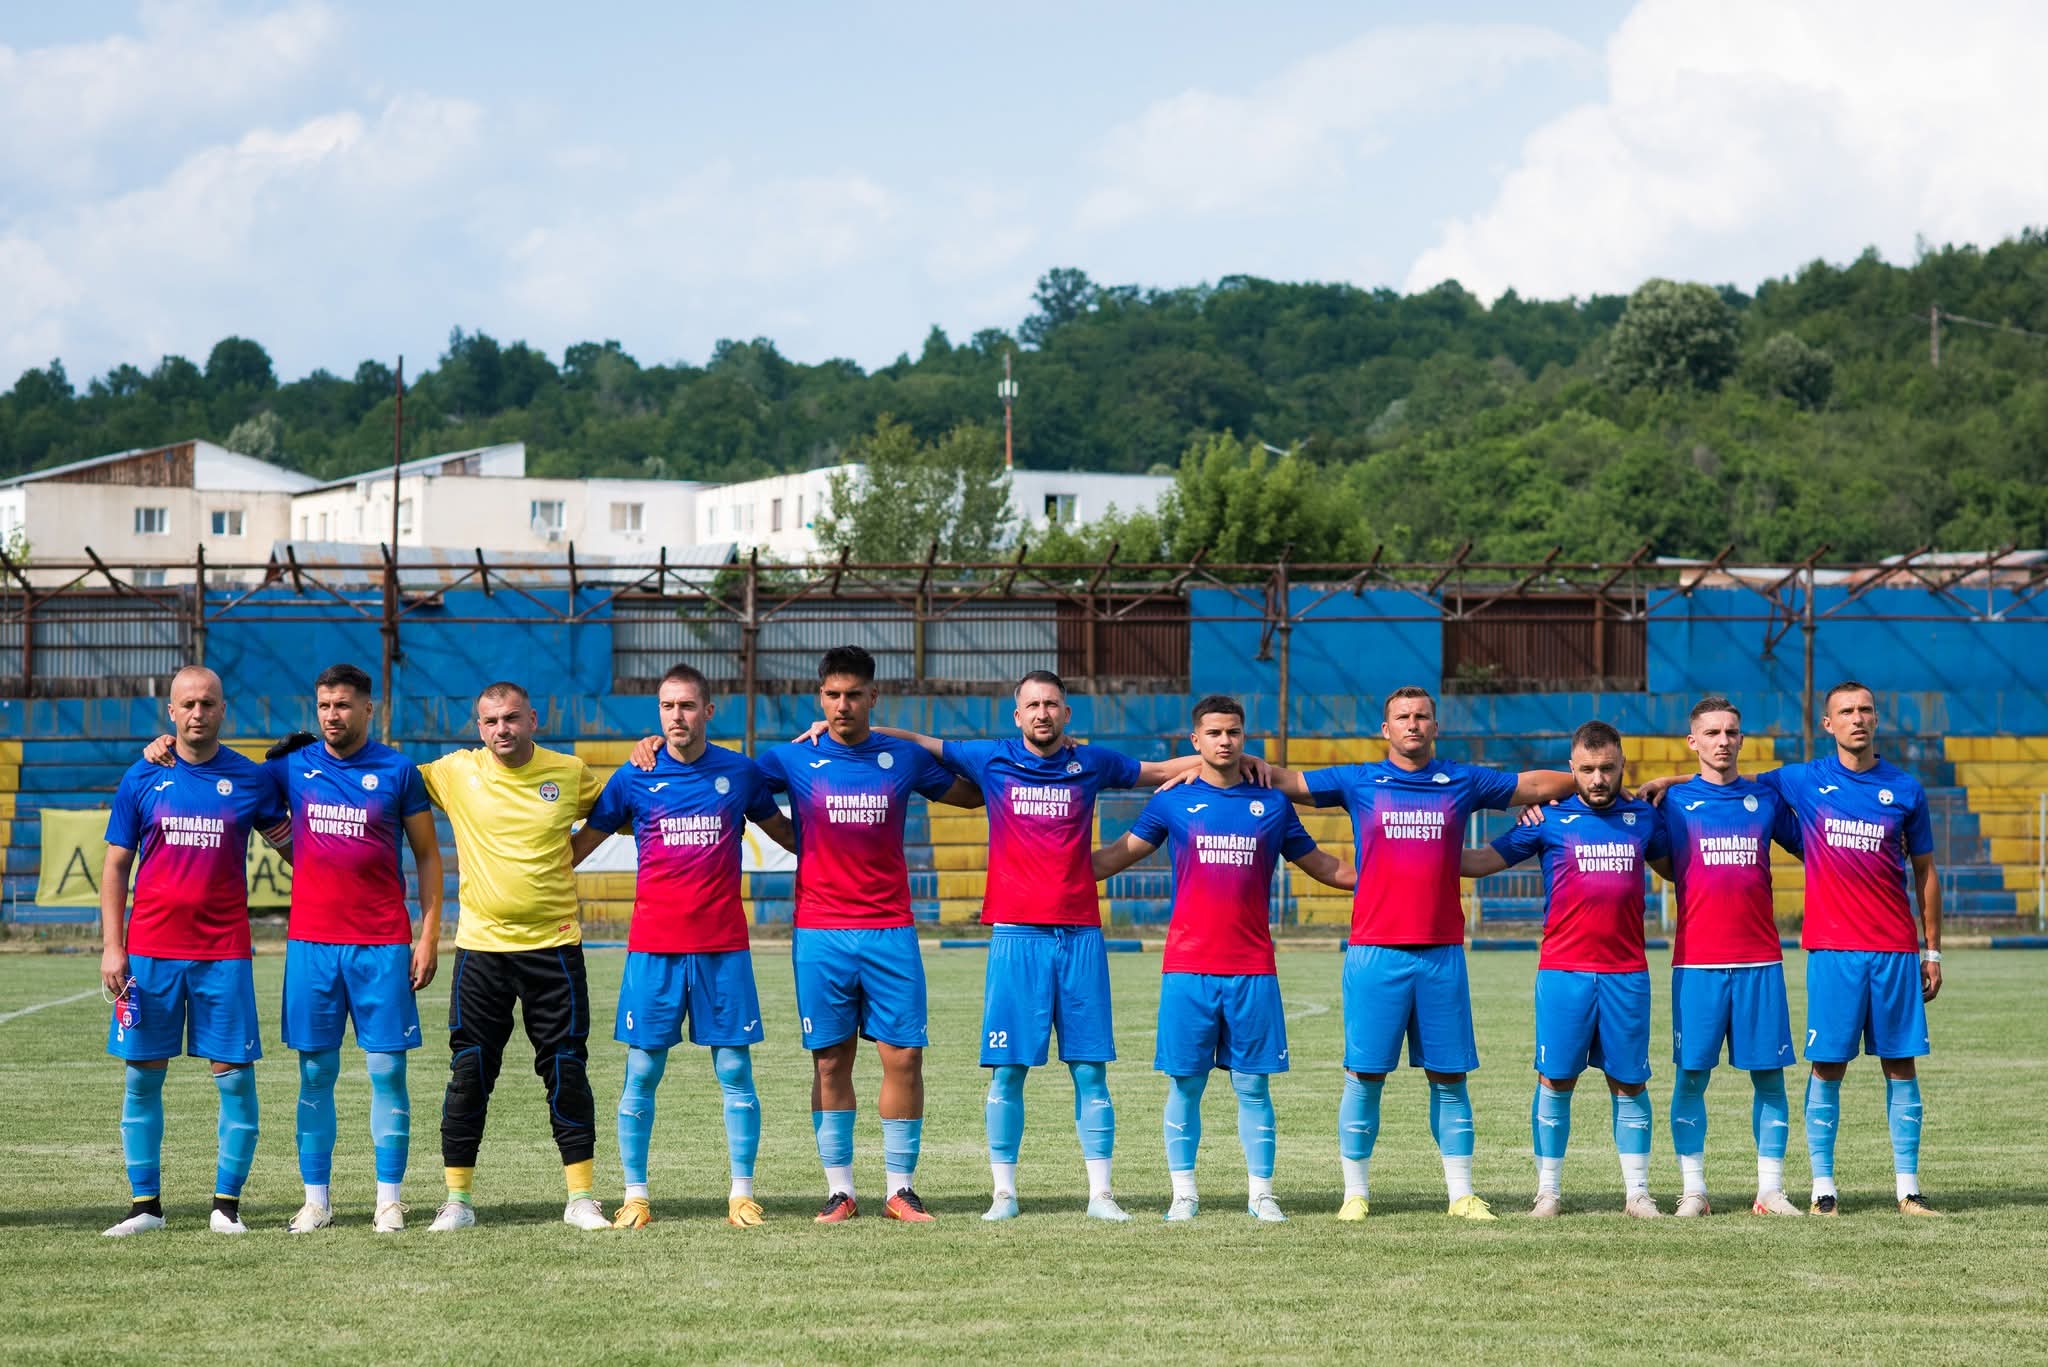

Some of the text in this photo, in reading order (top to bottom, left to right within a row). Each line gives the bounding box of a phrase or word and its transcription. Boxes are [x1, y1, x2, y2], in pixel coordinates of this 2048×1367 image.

[826, 792, 888, 809] PRIMĂRIA
[1011, 786, 1071, 802] PRIMĂRIA
[308, 803, 368, 823] PRIMĂRIA
[1382, 809, 1445, 825] PRIMĂRIA
[161, 815, 224, 833] PRIMĂRIA
[659, 814, 722, 833] PRIMĂRIA
[1824, 818, 1885, 839] PRIMĂRIA
[1196, 834, 1257, 851] PRIMĂRIA
[1575, 841, 1635, 858] PRIMĂRIA
[1700, 834, 1758, 851] PRIMĂRIA
[626, 1010, 634, 1030] 6
[117, 1023, 125, 1042] 5
[989, 1030, 1008, 1049] 22
[1808, 1028, 1817, 1047] 7
